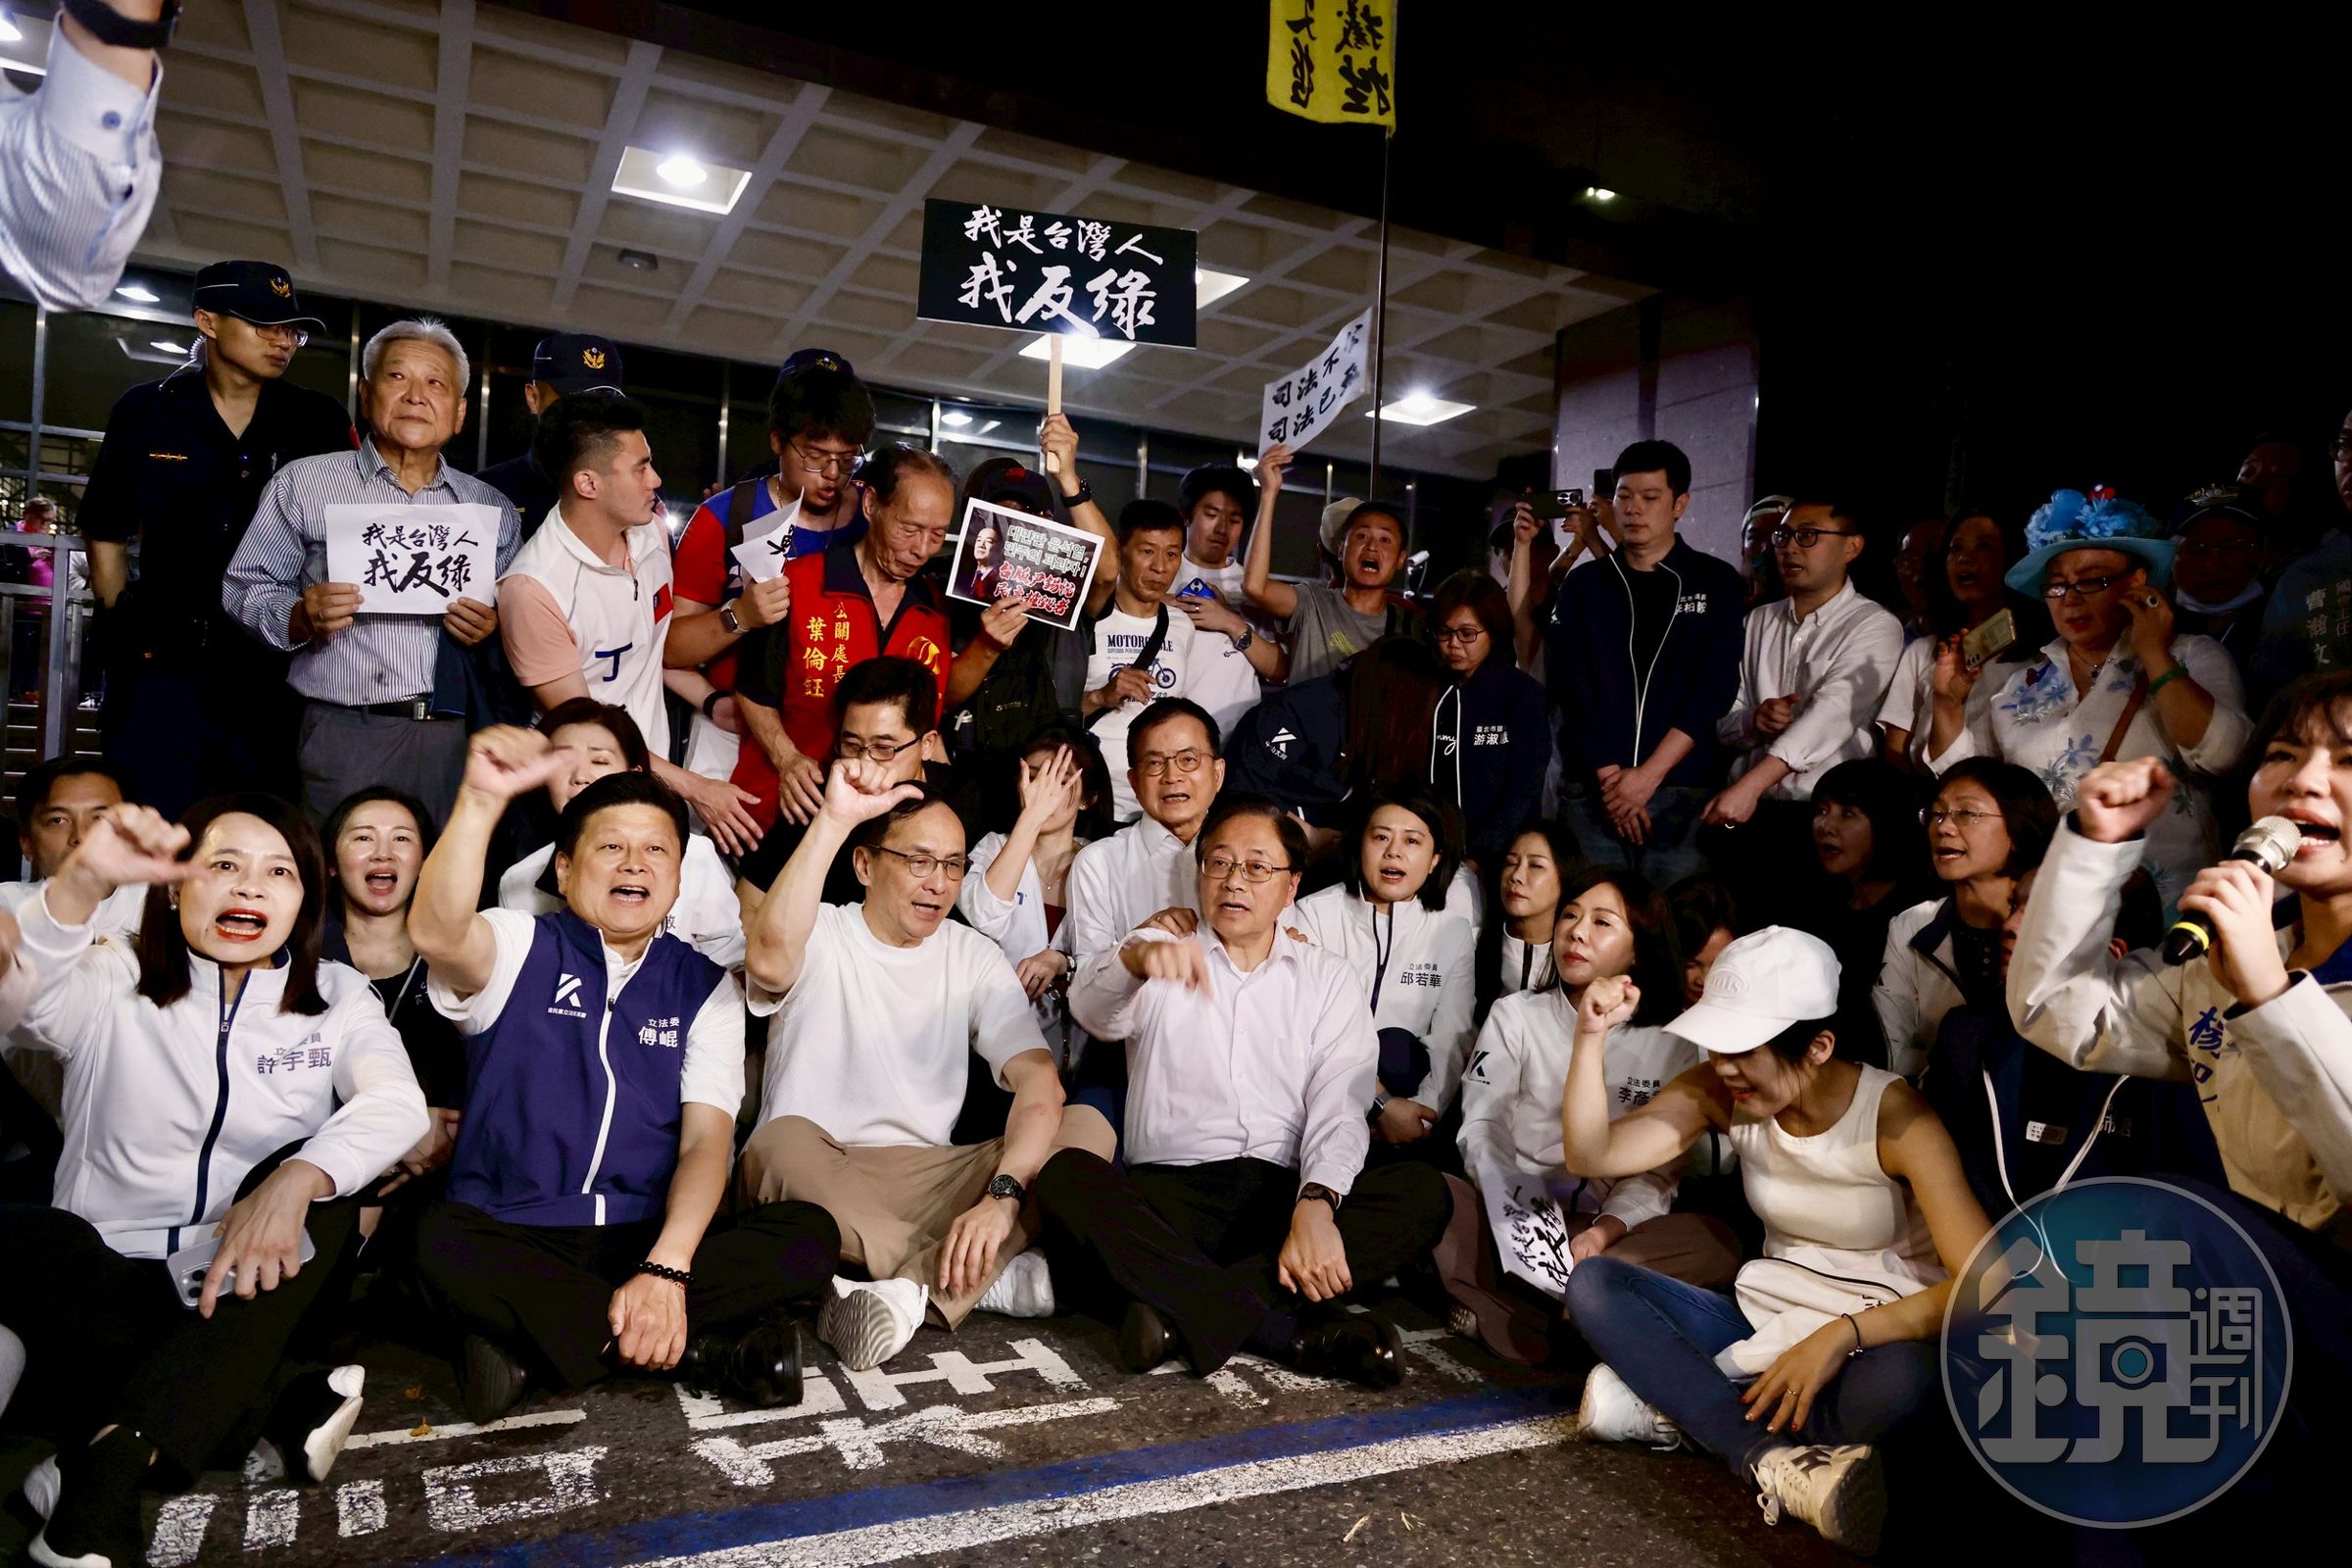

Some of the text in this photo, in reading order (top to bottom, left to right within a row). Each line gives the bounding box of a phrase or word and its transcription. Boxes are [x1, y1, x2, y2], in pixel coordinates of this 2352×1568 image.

[963, 205, 1163, 266] 我是台灣人
[957, 251, 1157, 340] 我反綠
[362, 522, 478, 551] 我是台灣人
[1006, 524, 1048, 550] 대만판
[1004, 540, 1042, 565] 민주의
[364, 549, 471, 598] 我反綠
[803, 616, 828, 699] 葉倫鈺
[831, 602, 851, 684] 公關處長
[1106, 634, 1174, 653] MOTORLE
[1400, 971, 1442, 988] 邱若華
[257, 1047, 332, 1074] 許宇甄
